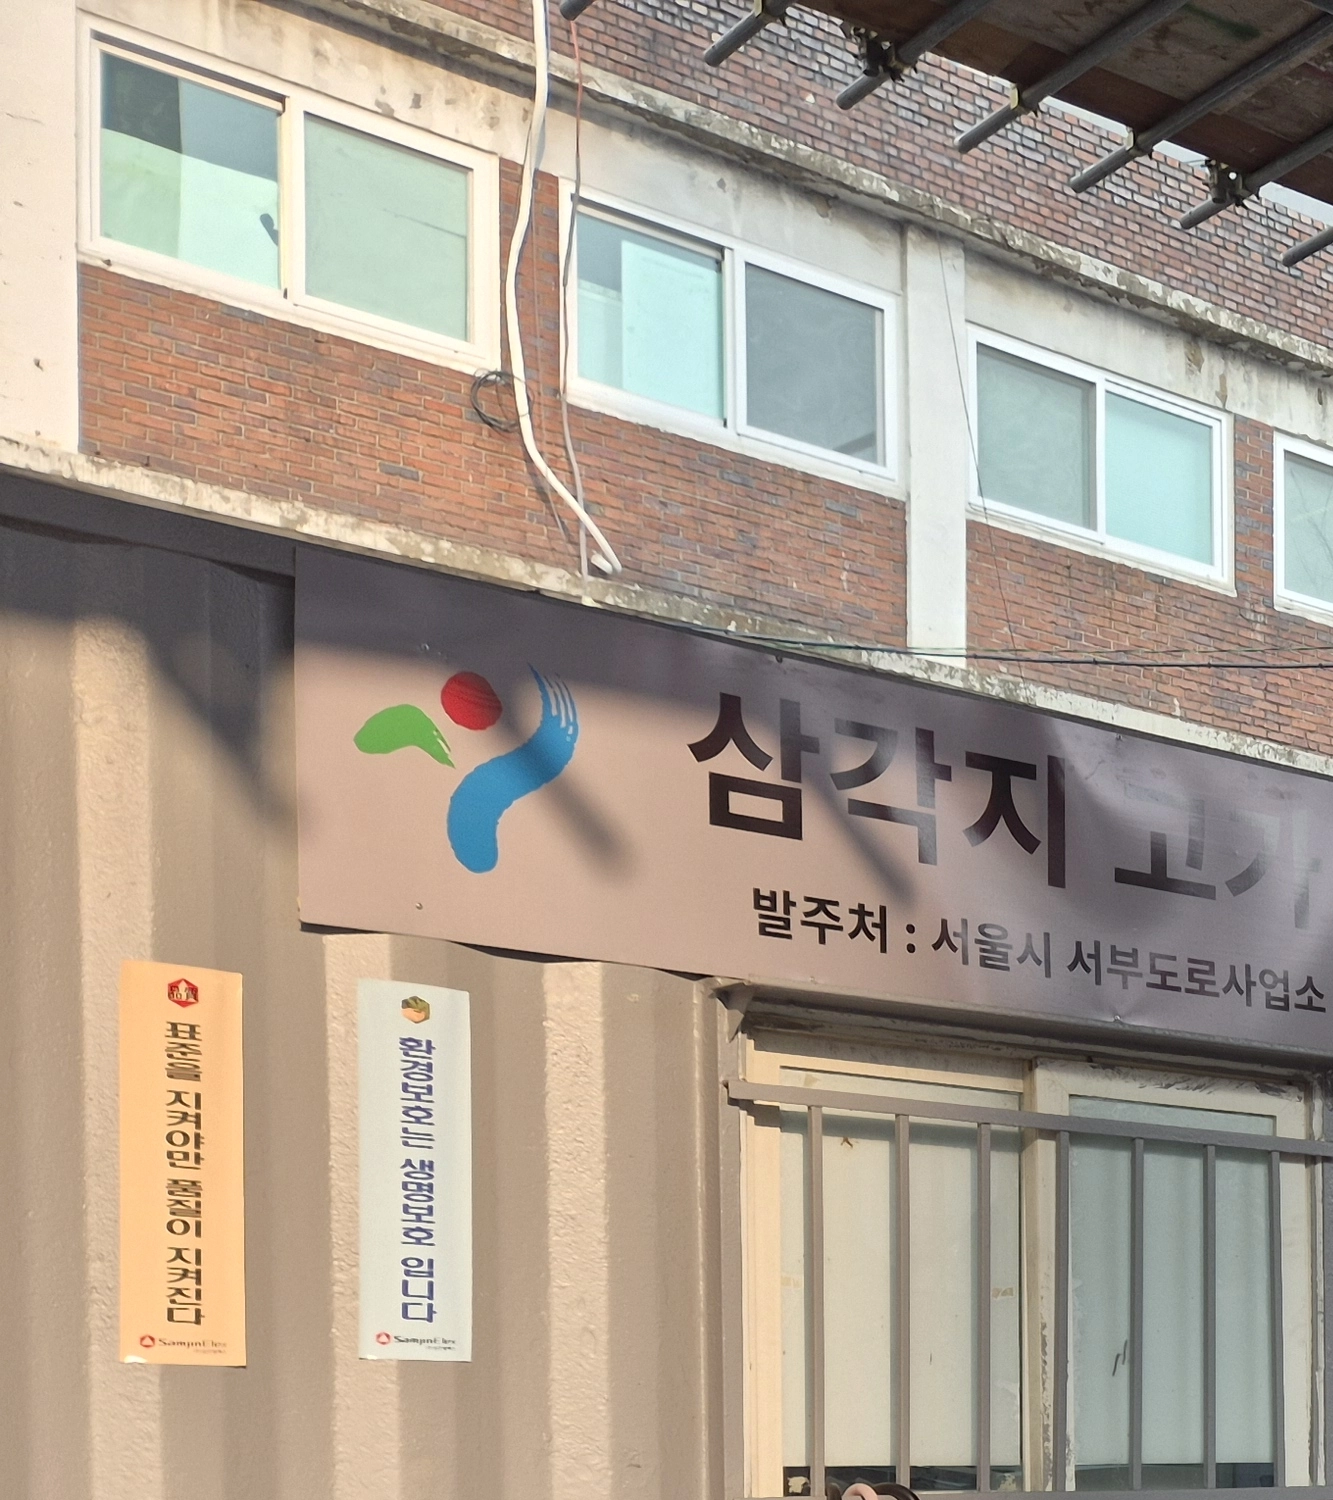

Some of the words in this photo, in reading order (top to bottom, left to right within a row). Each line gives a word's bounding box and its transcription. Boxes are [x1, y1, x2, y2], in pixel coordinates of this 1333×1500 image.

[686, 691, 1067, 888] 삼각지
[752, 888, 888, 953] 발주처
[931, 918, 1052, 979] 서울시
[1066, 939, 1327, 1013] 서부도로사업소
[165, 1021, 202, 1082] 표준을
[166, 1091, 205, 1170] 지켜야만
[399, 1036, 436, 1149] 환경보호는
[165, 1178, 202, 1238] 품질이
[400, 1159, 436, 1247] 생명보호
[166, 1247, 205, 1326] 지켜진다
[400, 1257, 437, 1323] 입니다
